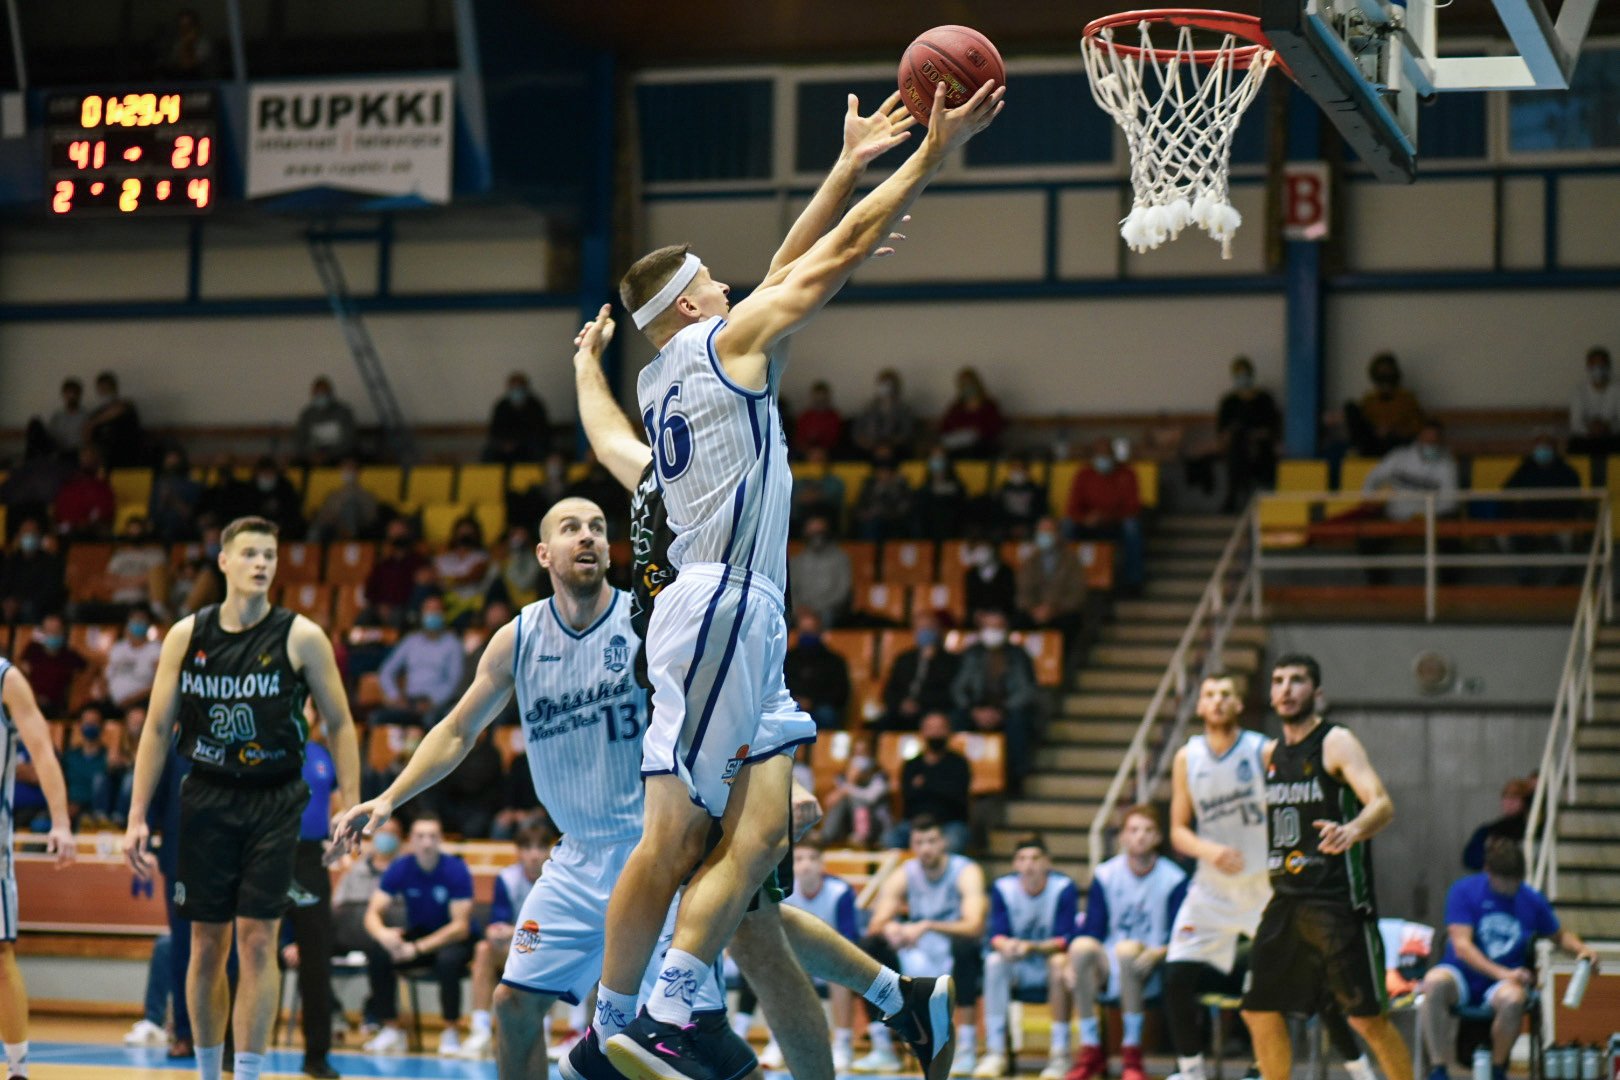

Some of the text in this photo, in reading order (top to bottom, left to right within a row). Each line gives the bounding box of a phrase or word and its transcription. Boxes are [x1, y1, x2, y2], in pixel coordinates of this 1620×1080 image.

[257, 90, 443, 131] RUPKKI
[69, 135, 211, 170] 41 21
[1285, 173, 1322, 226] B
[642, 381, 695, 490] 16
[209, 702, 257, 745] 20
[600, 702, 641, 743] 13
[1272, 806, 1300, 849] 10
